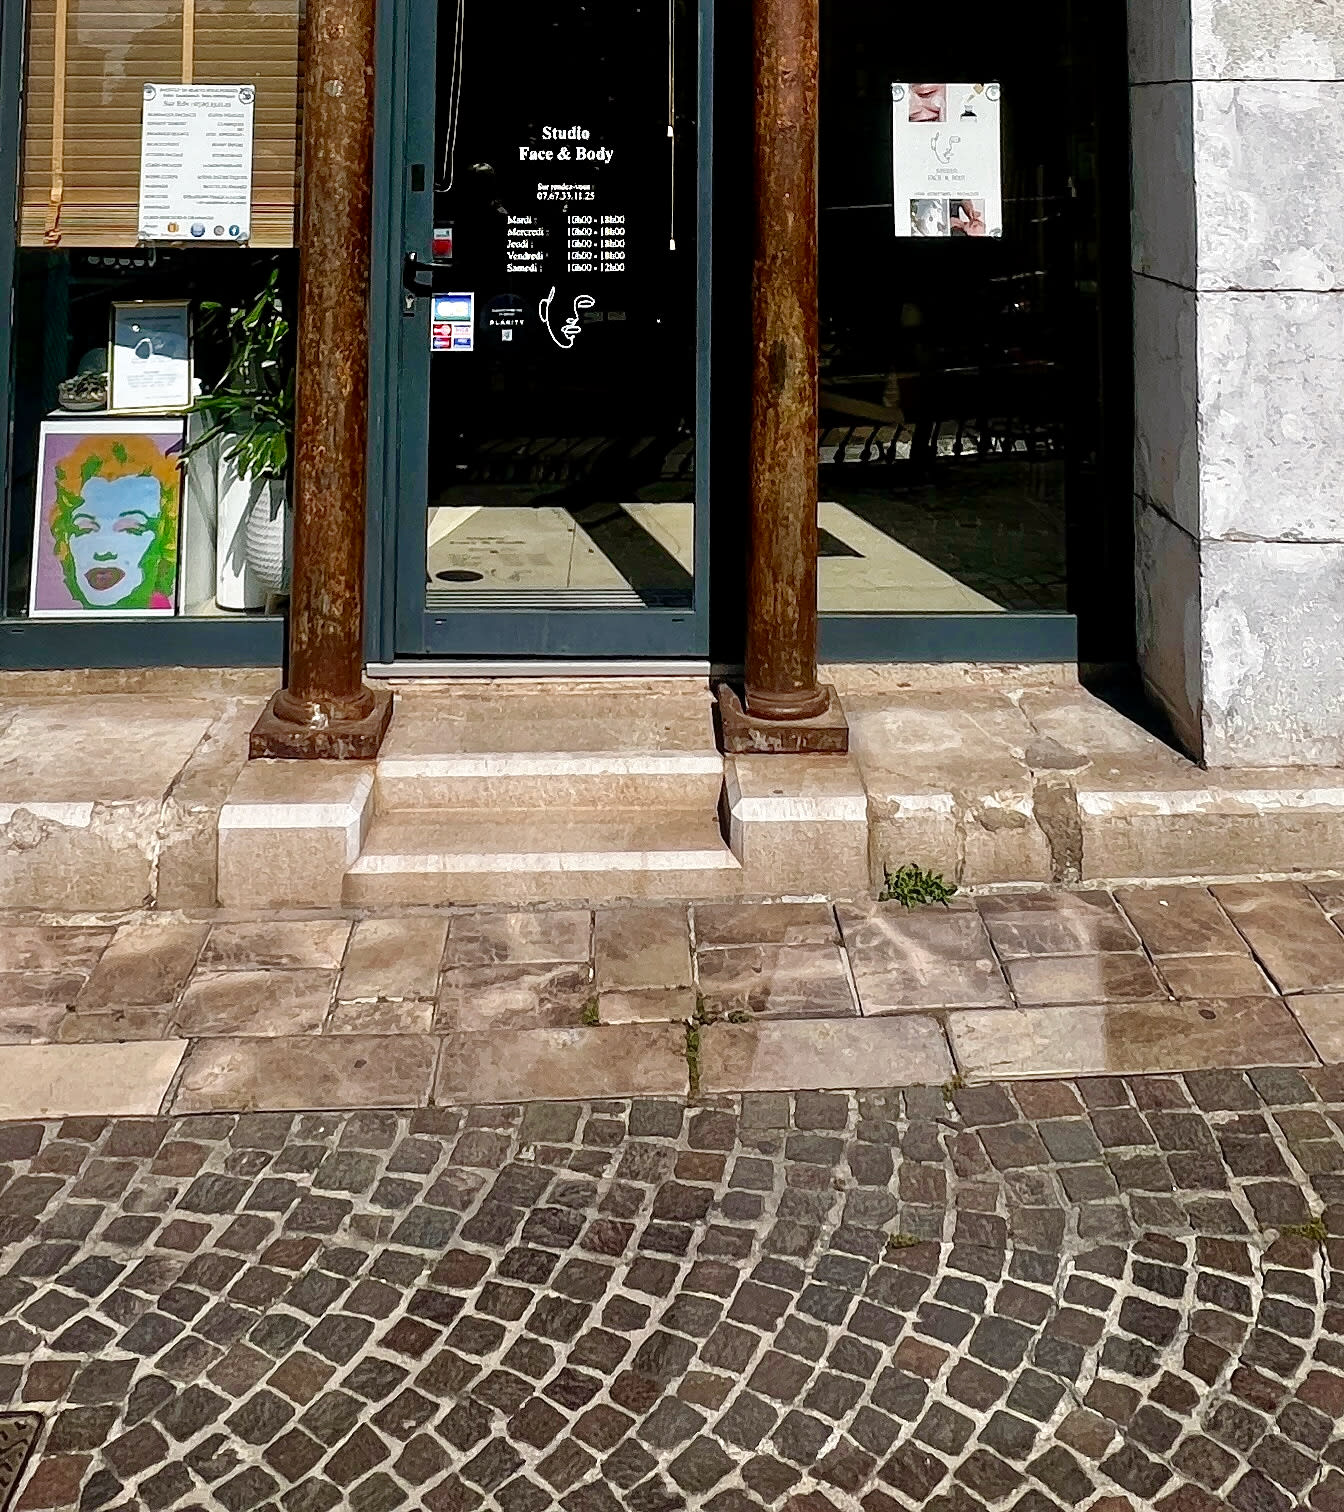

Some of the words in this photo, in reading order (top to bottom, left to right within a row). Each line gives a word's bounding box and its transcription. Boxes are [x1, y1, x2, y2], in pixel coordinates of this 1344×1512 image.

[542, 126, 590, 140] Studio
[519, 147, 554, 160] Face
[557, 147, 572, 160] &
[576, 147, 614, 164] Body
